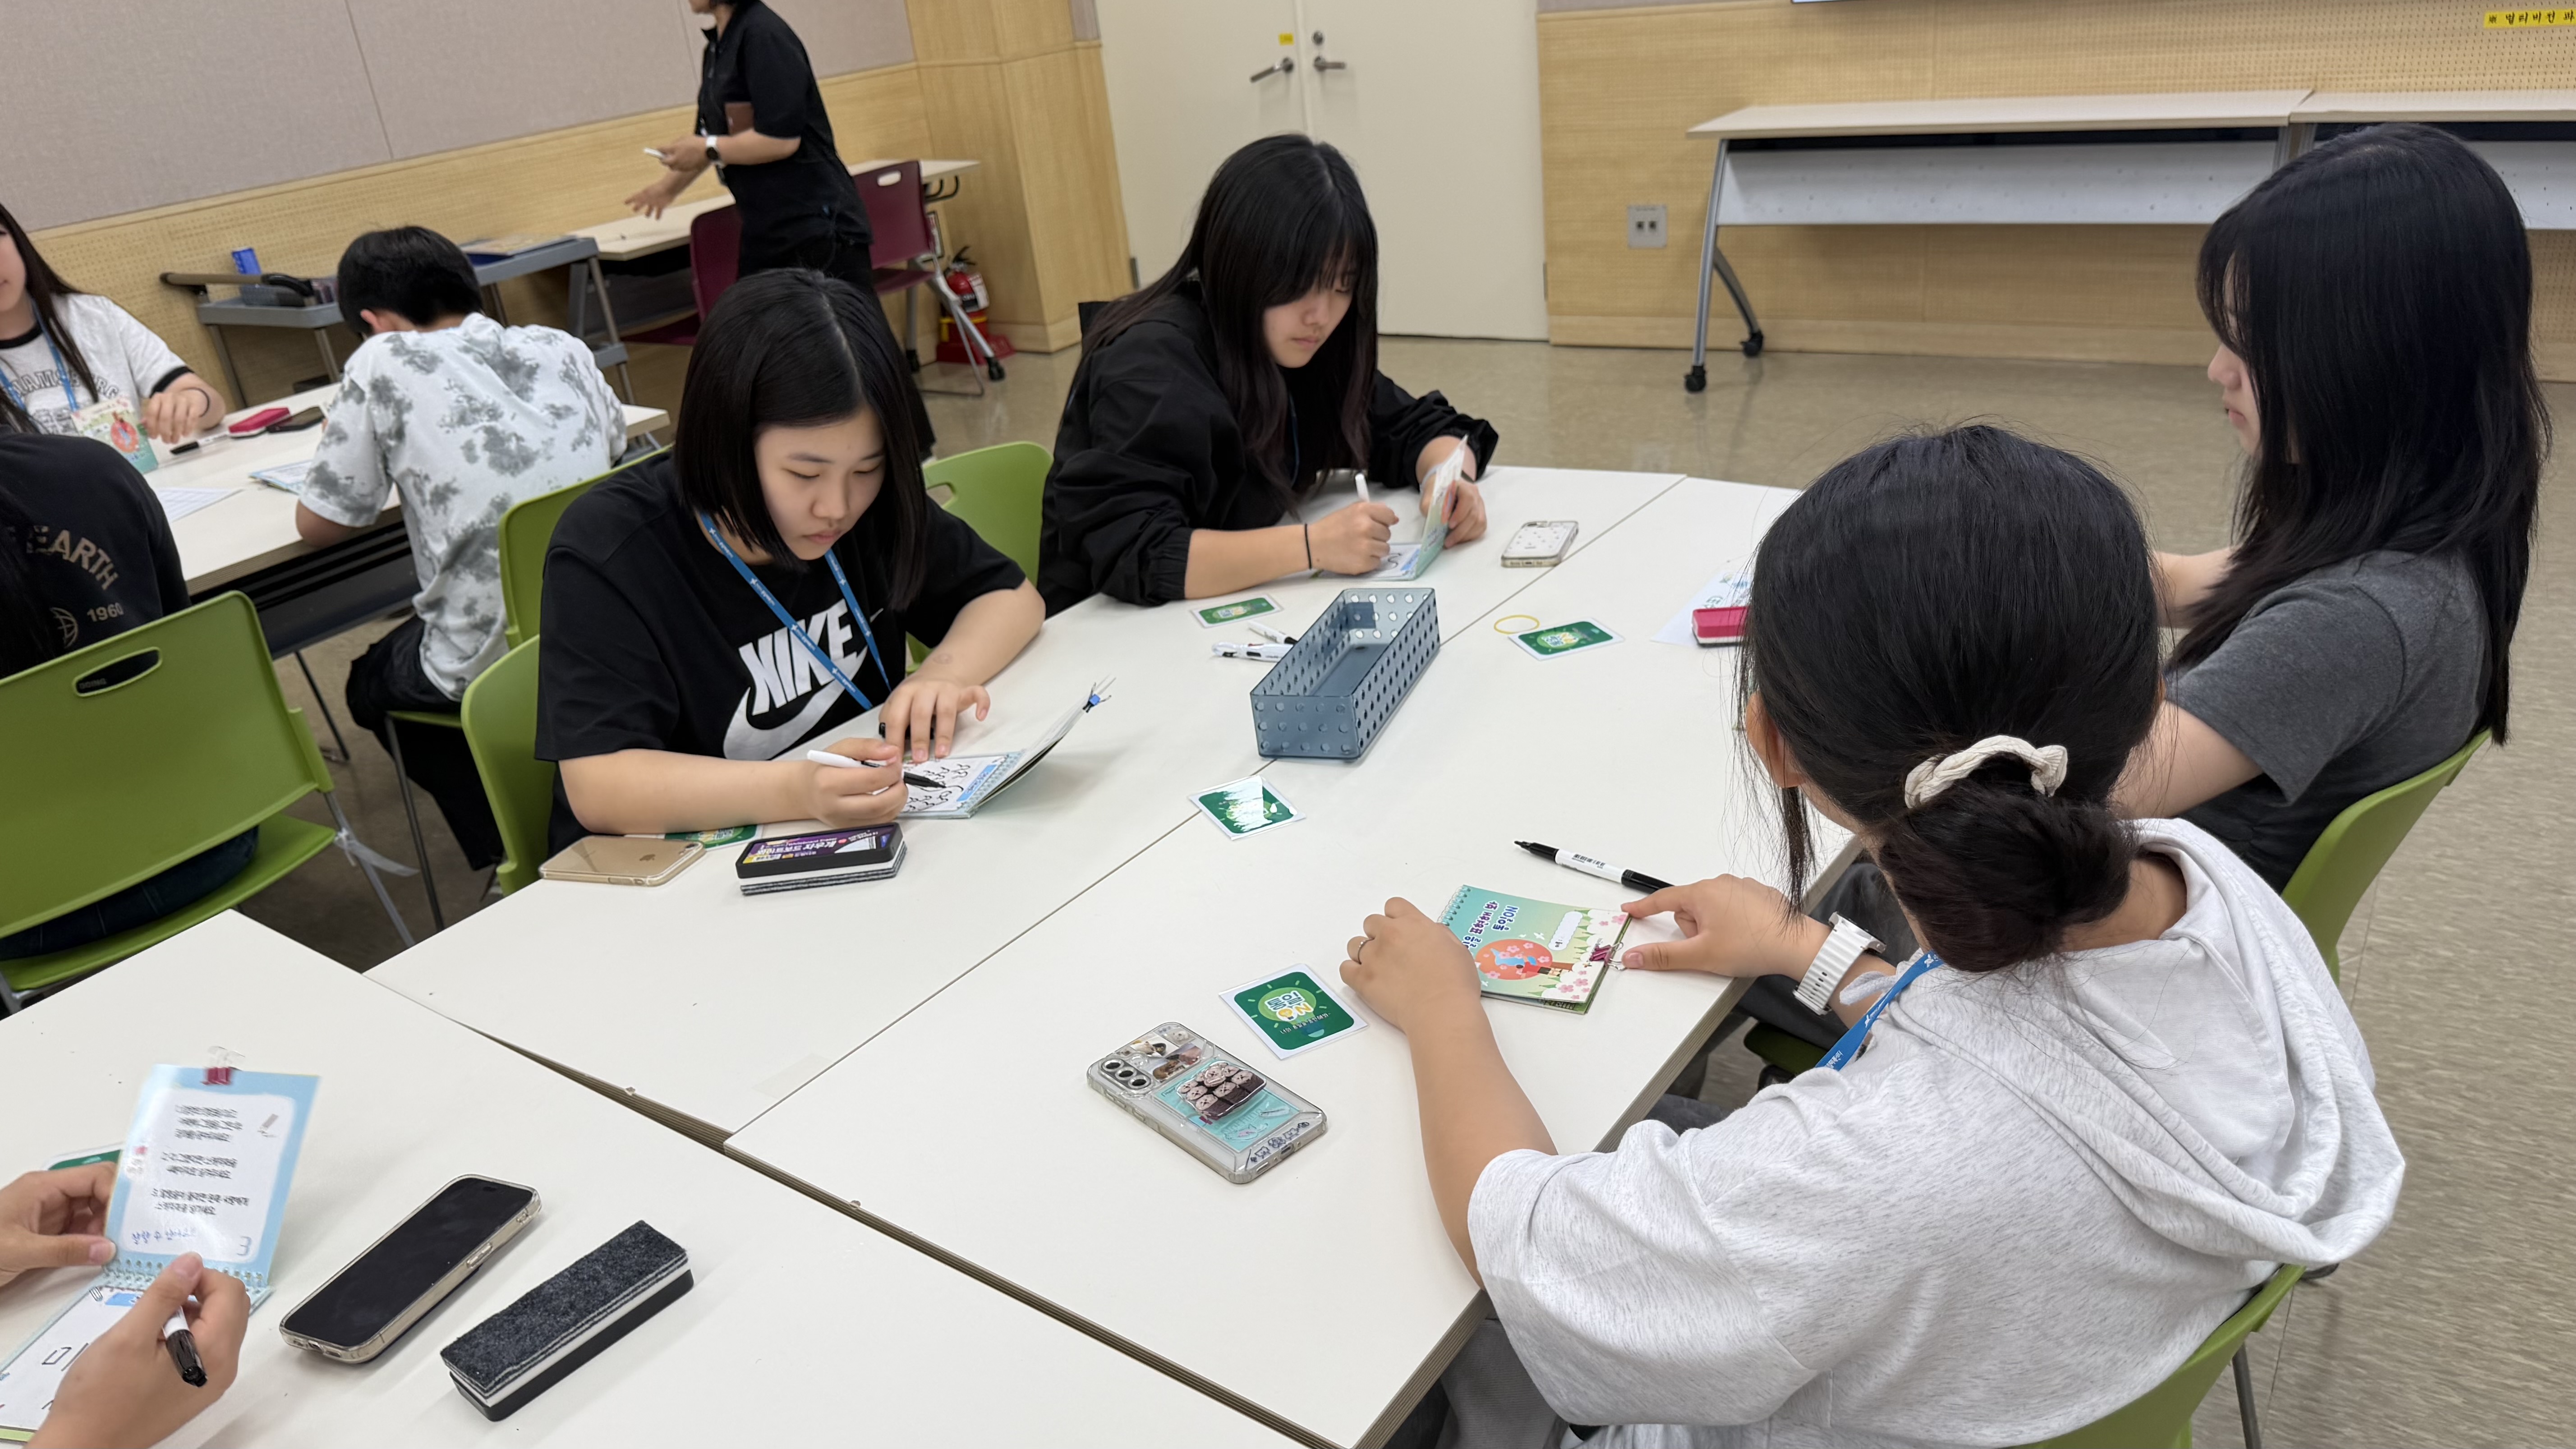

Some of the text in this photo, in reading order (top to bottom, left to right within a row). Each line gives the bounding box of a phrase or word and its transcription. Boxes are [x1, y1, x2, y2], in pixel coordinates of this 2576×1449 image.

[87, 602, 124, 623] 1960
[739, 598, 857, 716] NIKE
[1469, 910, 1492, 935] 표현해
[1485, 901, 1500, 911] 봐
[1492, 906, 1518, 931] 통일ON
[1266, 991, 1304, 1010] 통일
